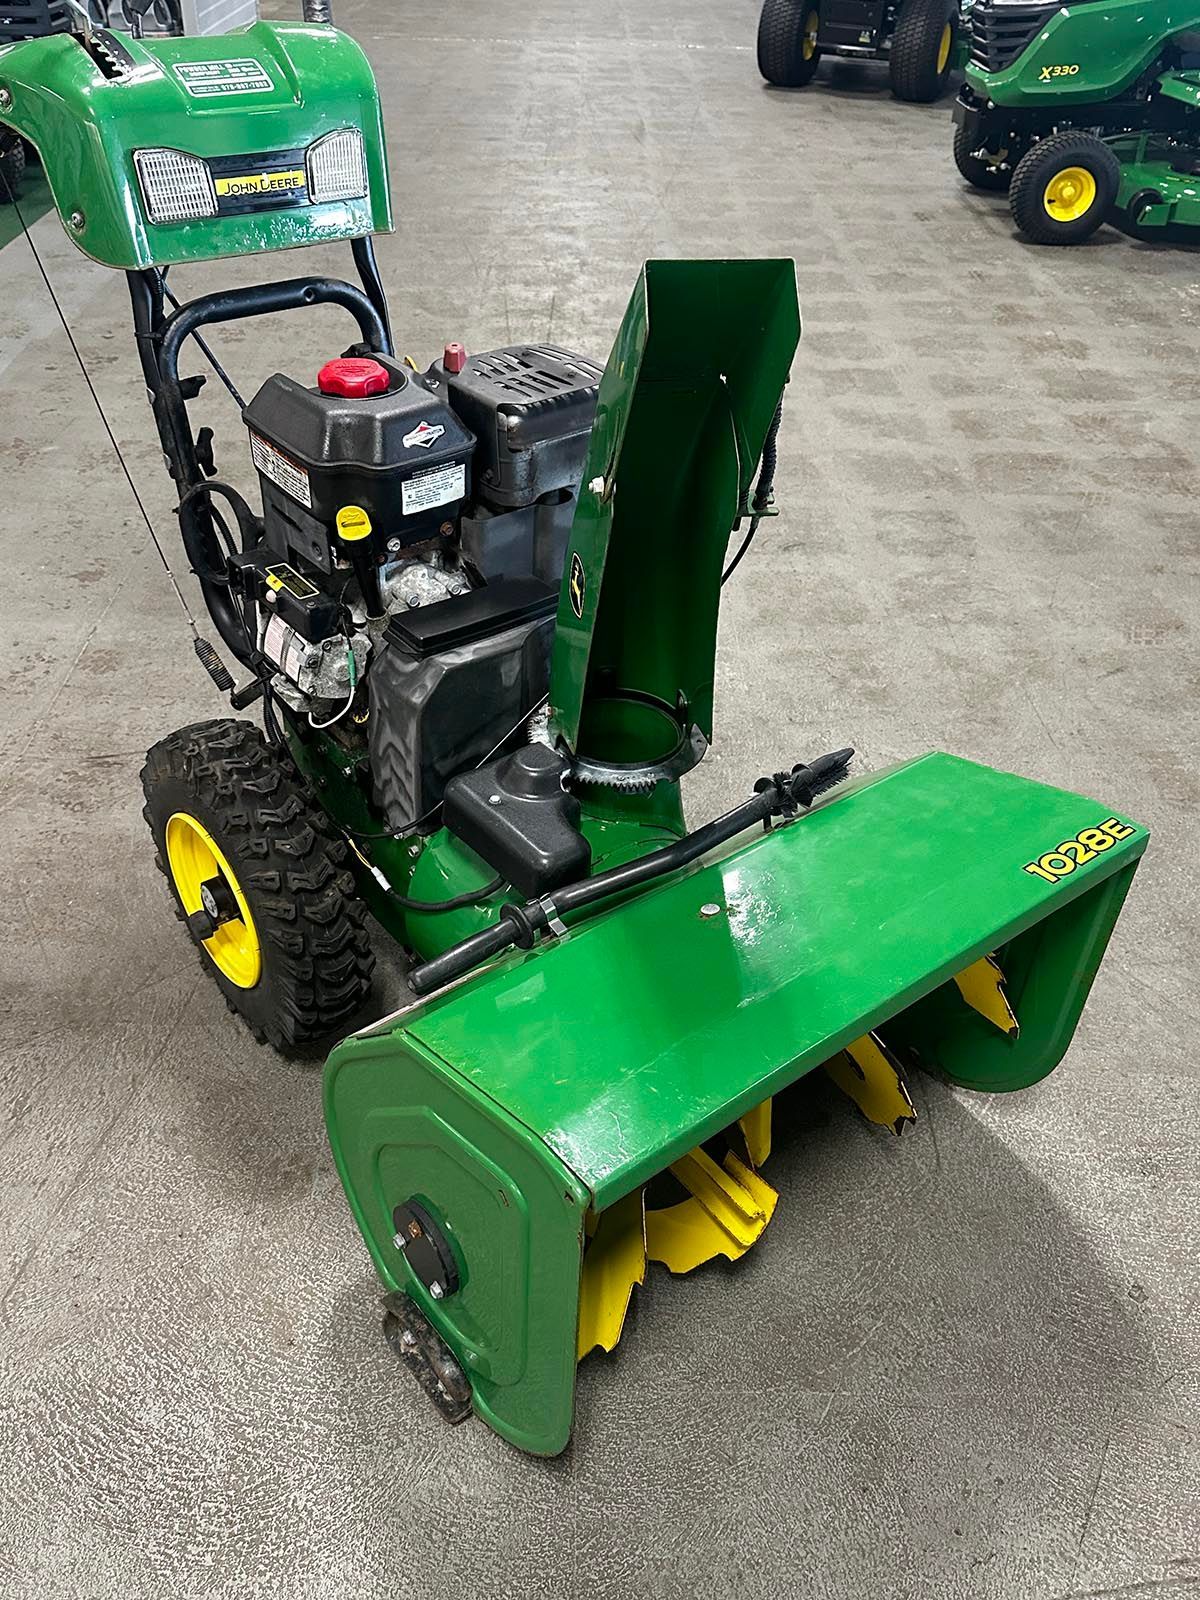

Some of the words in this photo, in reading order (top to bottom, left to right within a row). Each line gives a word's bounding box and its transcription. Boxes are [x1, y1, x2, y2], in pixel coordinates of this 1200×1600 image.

[1038, 64, 1080, 80] X330
[224, 183, 258, 195] JOHN
[260, 177, 300, 191] DEERE
[1022, 816, 1137, 885] 1028E
